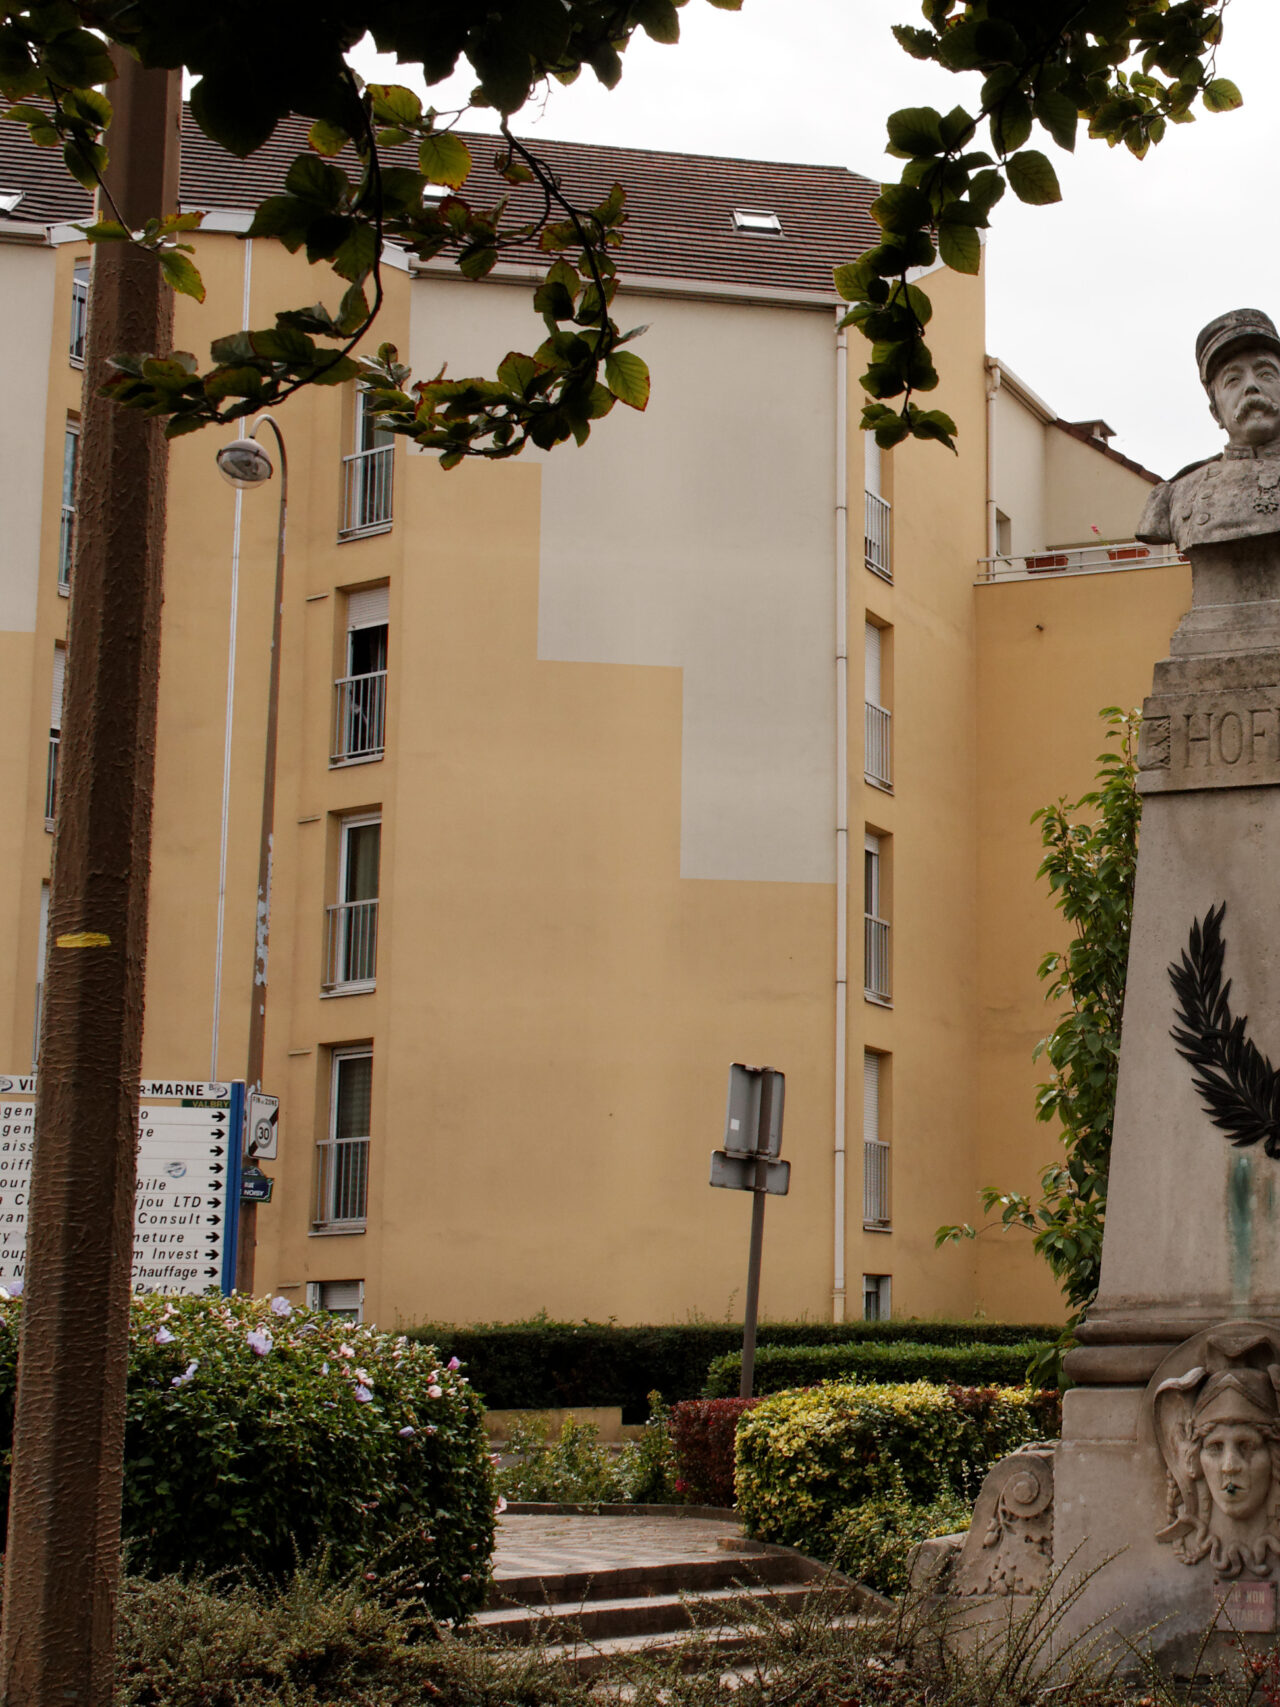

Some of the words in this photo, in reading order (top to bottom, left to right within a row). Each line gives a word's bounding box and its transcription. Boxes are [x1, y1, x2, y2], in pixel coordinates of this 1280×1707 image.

[19, 1078, 35, 1091] VI
[140, 1083, 204, 1096] R-MARNE
[192, 1100, 230, 1109] VALBRY
[258, 1126, 270, 1140] 30
[173, 1195, 202, 1208] LTD
[138, 1212, 201, 1225] Consult
[152, 1247, 199, 1260] Invest
[131, 1265, 198, 1281] Chauffage
